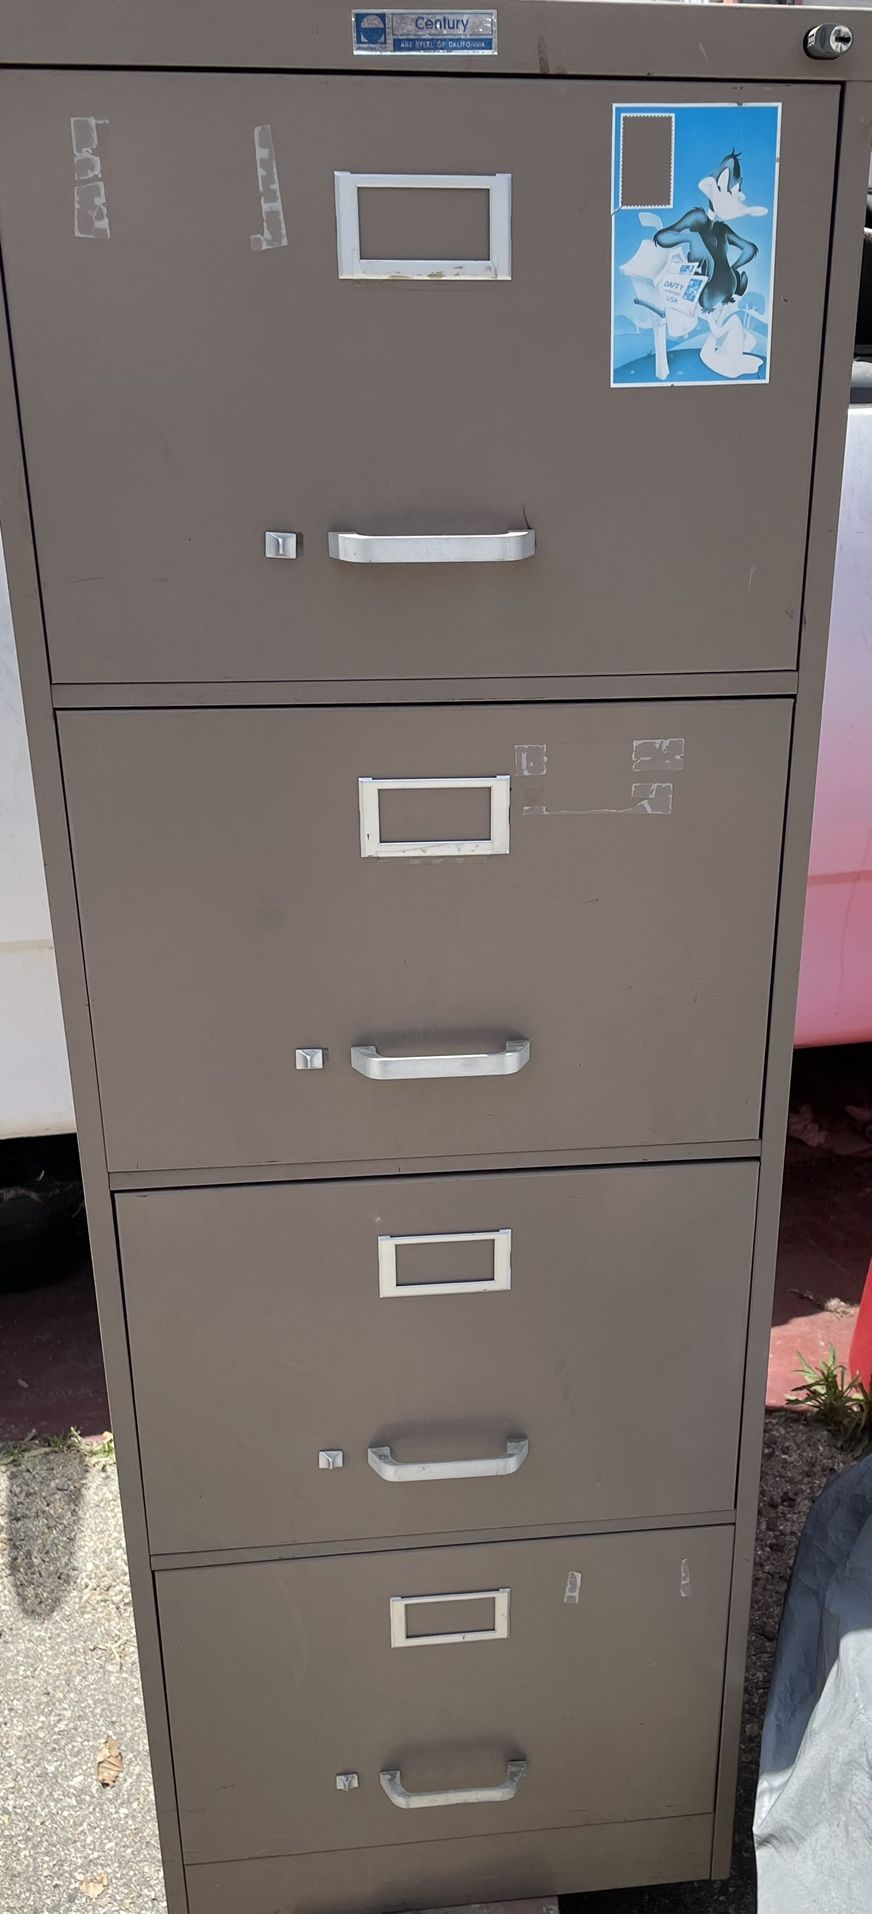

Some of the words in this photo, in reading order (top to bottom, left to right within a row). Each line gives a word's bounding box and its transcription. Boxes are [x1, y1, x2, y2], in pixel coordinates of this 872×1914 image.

[415, 16, 469, 32] Century
[437, 40, 446, 48] OF
[448, 40, 486, 48] CALIFORNIA
[663, 280, 685, 292] DAFFY
[666, 296, 678, 304] USA
